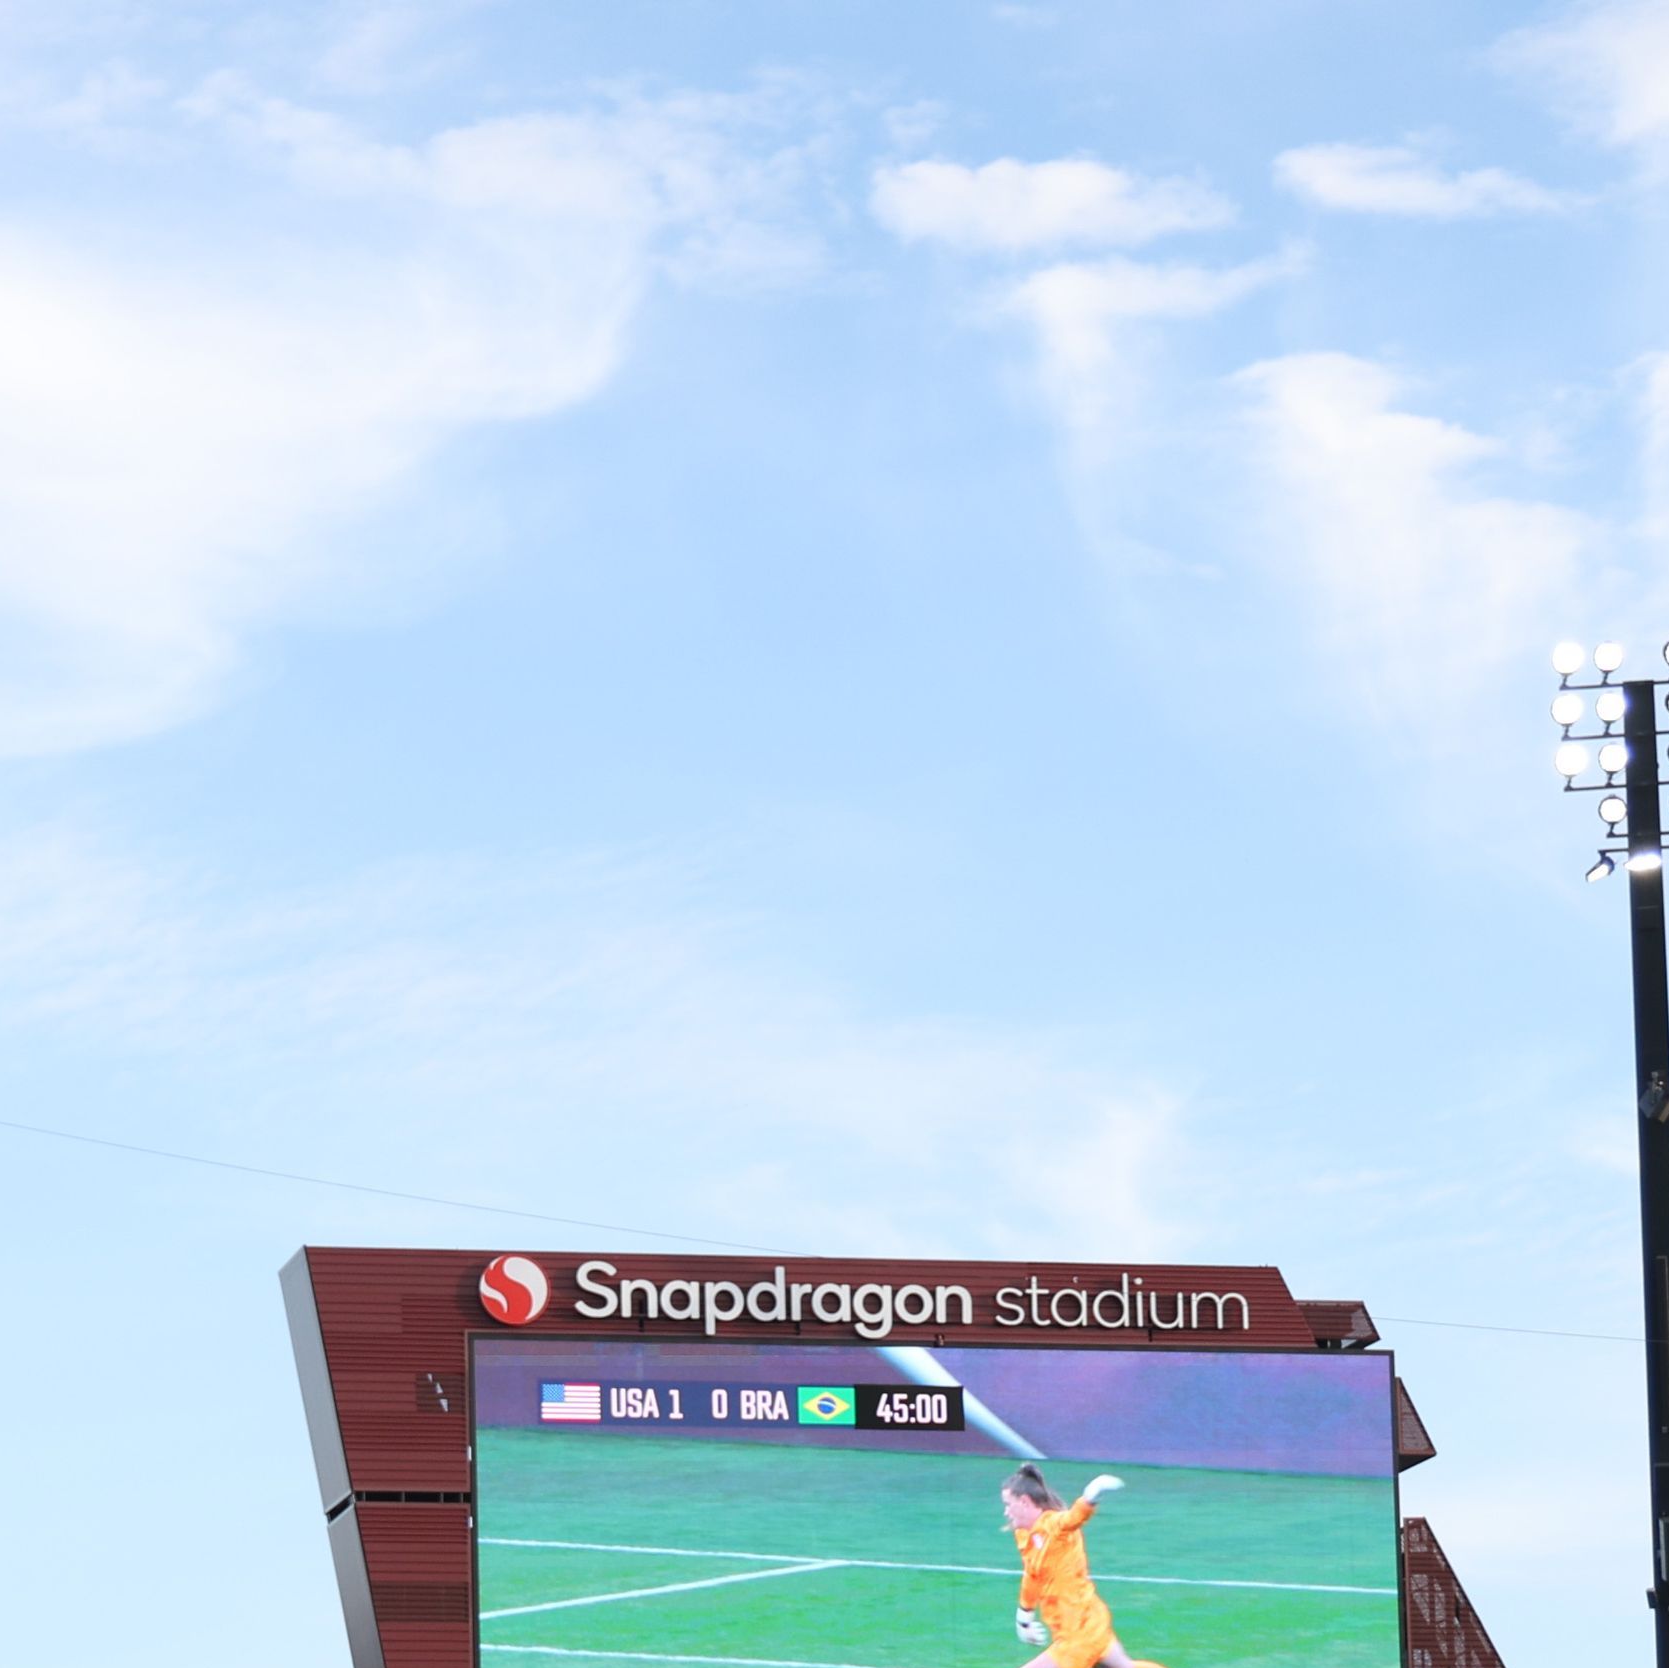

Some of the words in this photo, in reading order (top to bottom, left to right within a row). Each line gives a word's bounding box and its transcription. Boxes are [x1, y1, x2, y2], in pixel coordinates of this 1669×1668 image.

[574, 1260, 973, 1340] Snapdragon
[995, 1273, 1249, 1331] stadium
[610, 1388, 660, 1419] USA
[669, 1389, 681, 1420] 1
[711, 1389, 728, 1420] 0
[740, 1390, 790, 1422] BRA
[875, 1394, 948, 1425] 45:00
